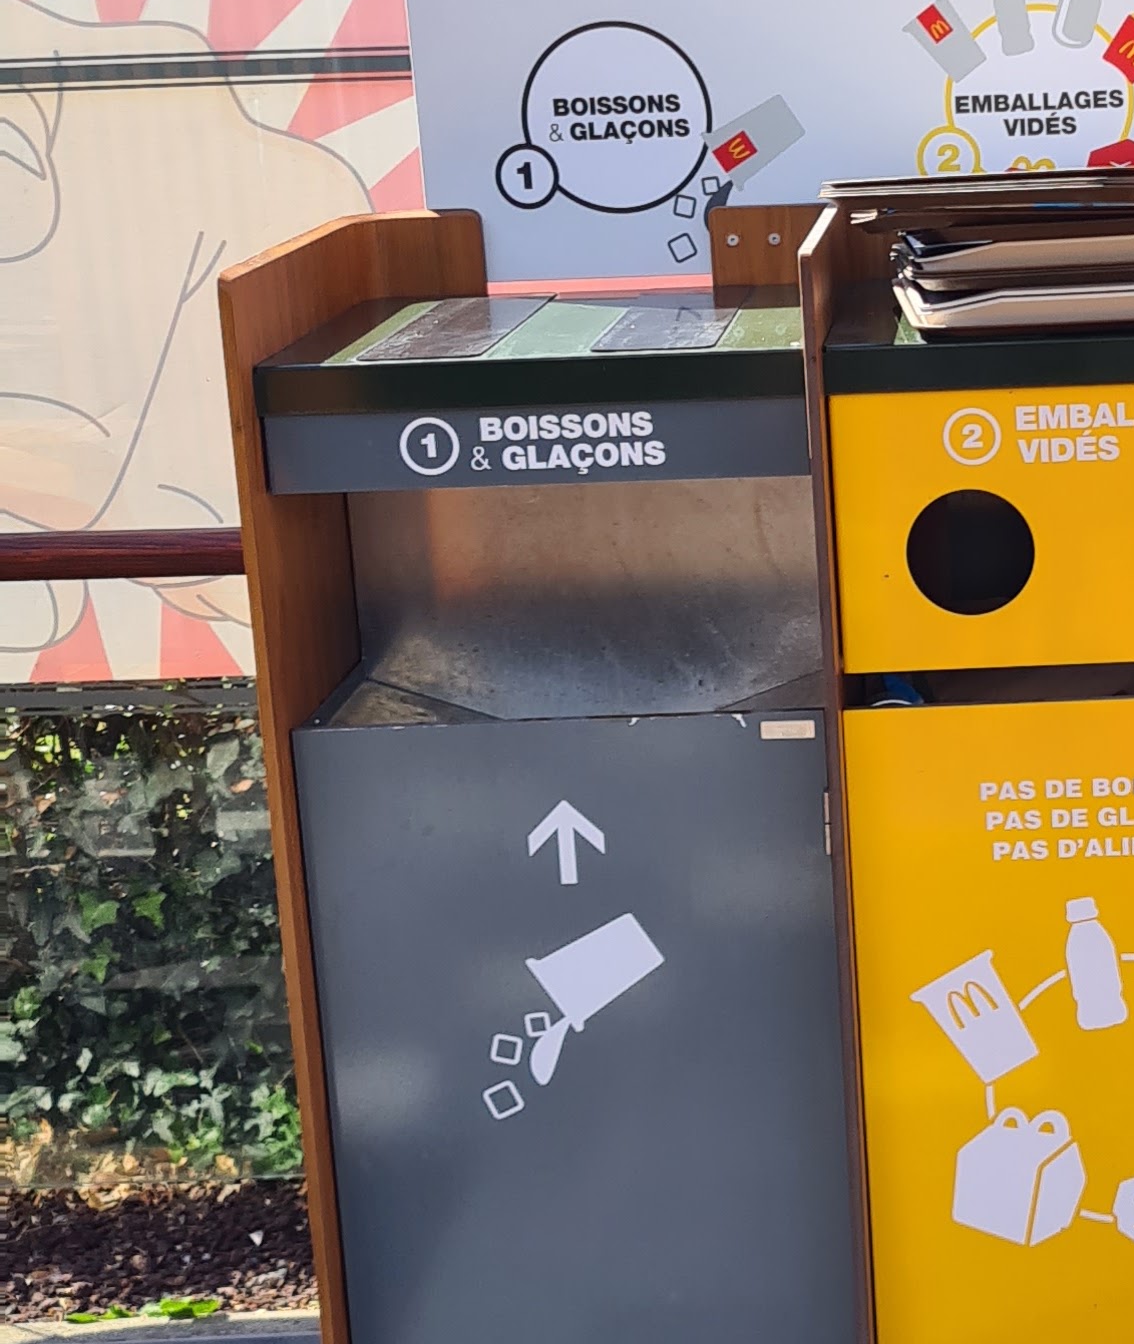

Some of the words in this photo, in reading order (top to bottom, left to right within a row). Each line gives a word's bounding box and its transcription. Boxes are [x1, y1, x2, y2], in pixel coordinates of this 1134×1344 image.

[552, 94, 680, 116] BOISSONS
[955, 90, 1123, 113] EMBALLAGES
[548, 123, 563, 142] &
[570, 119, 689, 144] GLAÇONS
[1003, 112, 1076, 136] VIDÉS
[937, 144, 960, 172] 2
[516, 162, 532, 189] 1
[480, 412, 653, 441] BOISSONS
[961, 424, 982, 448] 2
[420, 434, 436, 457] 1
[471, 447, 491, 470] &
[502, 440, 666, 474] GLAÇONS
[1017, 430, 1119, 463] VIDÉS
[980, 781, 1035, 801] PAS
[1046, 779, 1082, 798] DE
[986, 810, 1041, 830] PAS
[1052, 809, 1088, 827] DE
[993, 840, 1048, 860] PAS
